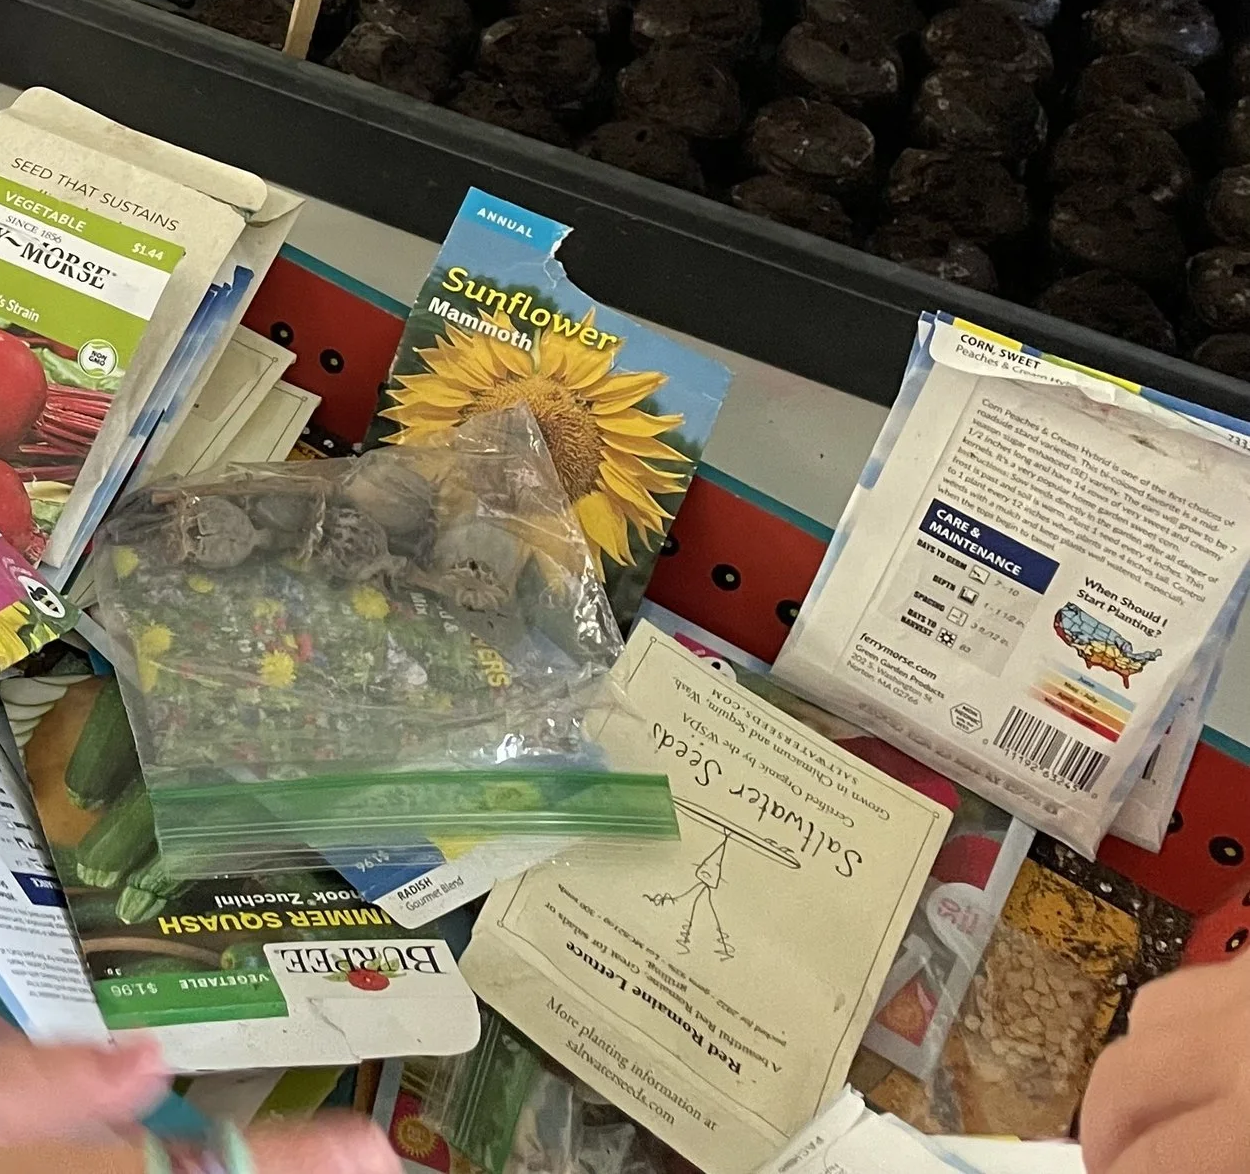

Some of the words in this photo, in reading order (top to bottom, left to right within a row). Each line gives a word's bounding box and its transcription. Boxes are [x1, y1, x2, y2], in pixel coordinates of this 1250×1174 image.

[11, 156, 53, 181] SEED
[56, 173, 99, 199] THAT
[99, 191, 179, 232] SUSTAINS
[3, 190, 86, 232] VEGETABLE
[131, 241, 164, 263] $1.44
[5, 214, 38, 234] SINCE
[40, 229, 62, 244] 1856
[476, 206, 534, 238] ANNUAL
[5, 299, 41, 323] Strain
[426, 296, 533, 352] Mammoth
[441, 265, 618, 351] Sunflower
[87, 355, 105, 367] GMO
[91, 349, 107, 361] NON
[955, 344, 999, 367] Peaches
[999, 360, 1010, 369] &
[959, 333, 997, 355] CORN,
[999, 348, 1040, 370] SWEET
[976, 407, 1013, 430] roadside
[1013, 426, 1039, 443] stand
[1079, 458, 1098, 472] This
[980, 397, 1003, 413] Corn
[1004, 409, 1040, 431] Peaches
[1049, 431, 1079, 450] Cream
[1079, 446, 1111, 467] Hybrid
[1150, 483, 1167, 495] the
[1167, 491, 1187, 505] first
[1187, 500, 1222, 522] choices
[983, 435, 1012, 454] inches
[1012, 449, 1032, 465] long
[1050, 469, 1073, 484] have
[1073, 480, 1086, 491] 14
[1010, 472, 1029, 486] Sow
[934, 508, 970, 532] CARE
[969, 526, 982, 538] &
[936, 486, 960, 501] when
[960, 497, 975, 509] the
[994, 515, 1019, 532] begin
[927, 521, 1023, 575] MAINTENANCE
[1082, 576, 1119, 601] When
[1119, 596, 1161, 623] Should
[1170, 580, 1206, 603] Control
[1076, 588, 1106, 609] Start
[1105, 605, 1162, 640] Planting?
[854, 643, 880, 661] Green
[879, 658, 909, 678] Garden
[908, 675, 946, 699] Products
[859, 631, 939, 680] ferrymorse.com
[668, 676, 704, 703] Wash.
[850, 652, 867, 665] 202
[874, 666, 923, 697] Washington
[876, 677, 892, 689] MA
[891, 686, 919, 705] 02766
[679, 712, 721, 742] WSDA
[709, 688, 858, 785] SALTWATERSEEDS.COM
[748, 728, 771, 747] and
[642, 724, 724, 788] Seeds
[721, 739, 740, 755] the
[740, 750, 758, 766] by
[757, 760, 805, 796] Organic
[770, 742, 834, 788] Chimacum
[1002, 748, 1038, 772] 11192
[1042, 769, 1079, 792] 63245
[834, 782, 848, 795] in
[804, 792, 855, 829] Certified
[849, 790, 891, 821] Grown
[724, 778, 863, 878] Saltwater
[213, 889, 303, 910] Zucchini
[396, 875, 433, 901] RADISH
[404, 887, 442, 912] Gourmet
[439, 875, 464, 893] Blend
[157, 907, 281, 936] SQUASH
[543, 901, 556, 913] or
[555, 911, 590, 940] salads
[279, 944, 446, 974] BURPEE
[590, 937, 607, 953] for
[608, 948, 640, 975] Great
[178, 972, 269, 989] VEGETABLE
[563, 940, 629, 990] Lettuce
[629, 984, 708, 1046] Romaine
[692, 1009, 718, 1032] Red
[545, 997, 581, 1028] More
[578, 1023, 632, 1069] planting
[630, 1060, 704, 1120] information
[703, 1117, 717, 1131] at
[704, 1041, 744, 1074] Red
[717, 1027, 770, 1068] beautiful
[565, 1035, 678, 1125] saltwaterseeds.com
[768, 1061, 781, 1074] A
